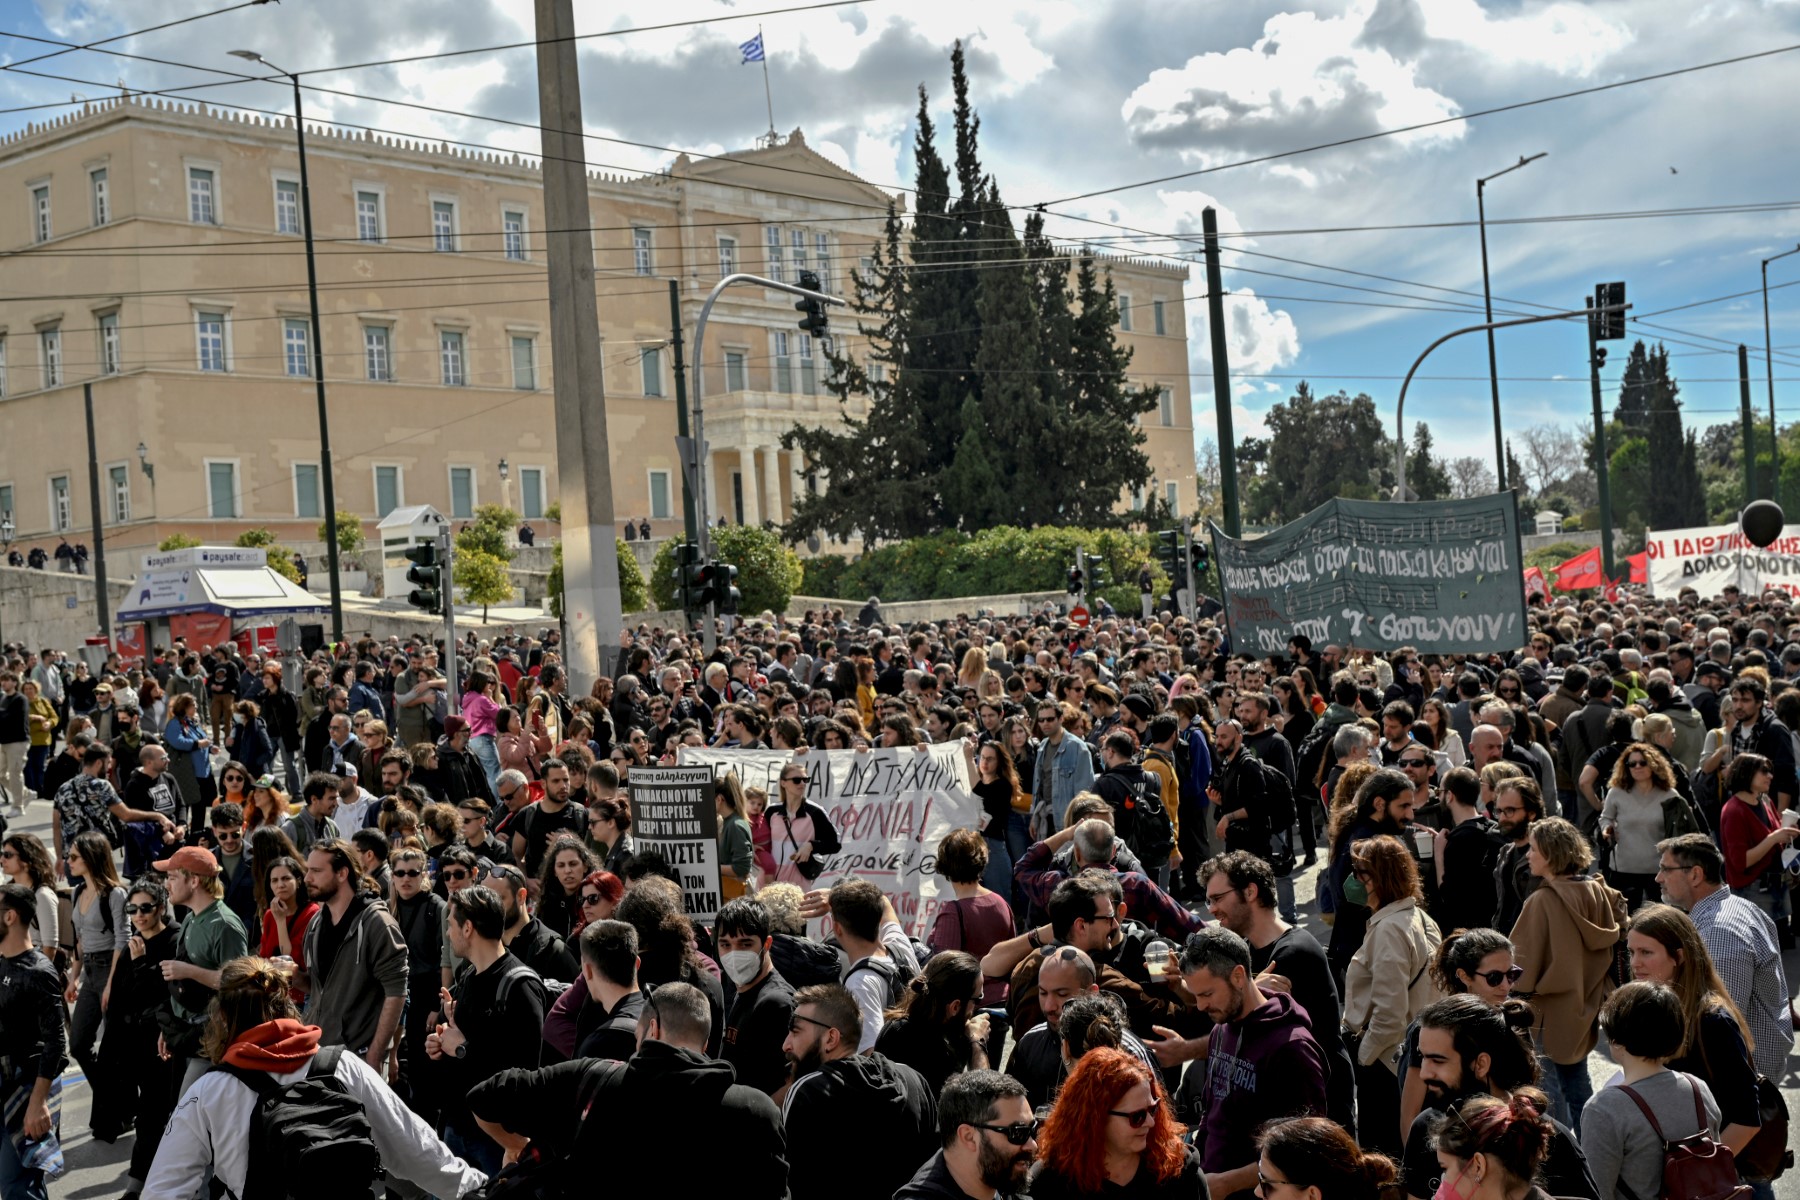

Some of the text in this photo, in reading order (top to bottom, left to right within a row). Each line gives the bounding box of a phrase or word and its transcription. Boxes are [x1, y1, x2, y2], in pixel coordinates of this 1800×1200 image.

[1646, 540, 1665, 559] ΟΙ
[152, 554, 188, 566] paysafecard
[210, 552, 258, 563] paysafecard
[766, 760, 831, 799] ΕΑΙ
[640, 805, 694, 819] ΤΙΣ ΑΠΕΡΓΙΕΣ
[829, 797, 934, 843] ΟΦΟΝΙΑ!
[638, 820, 702, 835] ΜΕΧΡΙ ΤΗ ΝΙΚΗ
[684, 875, 705, 889] ΤΟΝ
